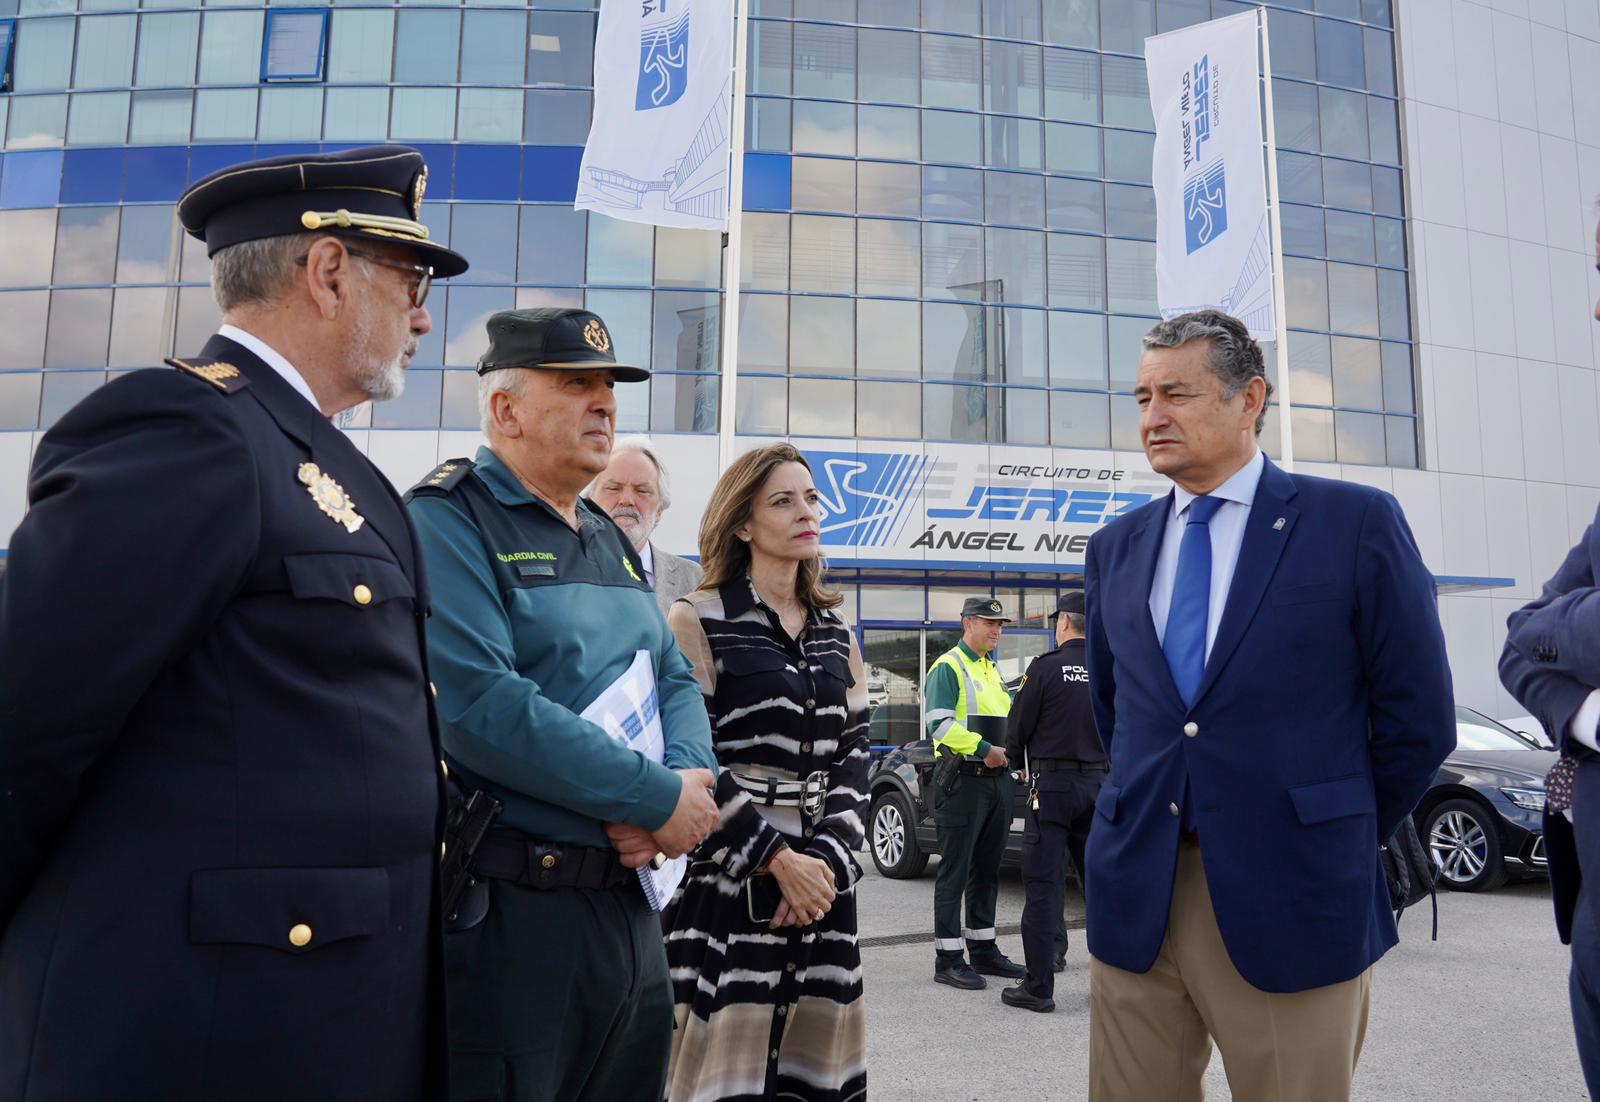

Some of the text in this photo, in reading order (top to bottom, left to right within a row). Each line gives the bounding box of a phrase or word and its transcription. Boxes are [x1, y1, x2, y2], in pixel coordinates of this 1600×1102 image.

[998, 465, 1125, 481] CIRCUITO DE
[926, 486, 1153, 524] JEREZ
[909, 524, 1092, 553] ÁNGEL NIE
[497, 552, 537, 562] GUARDIA
